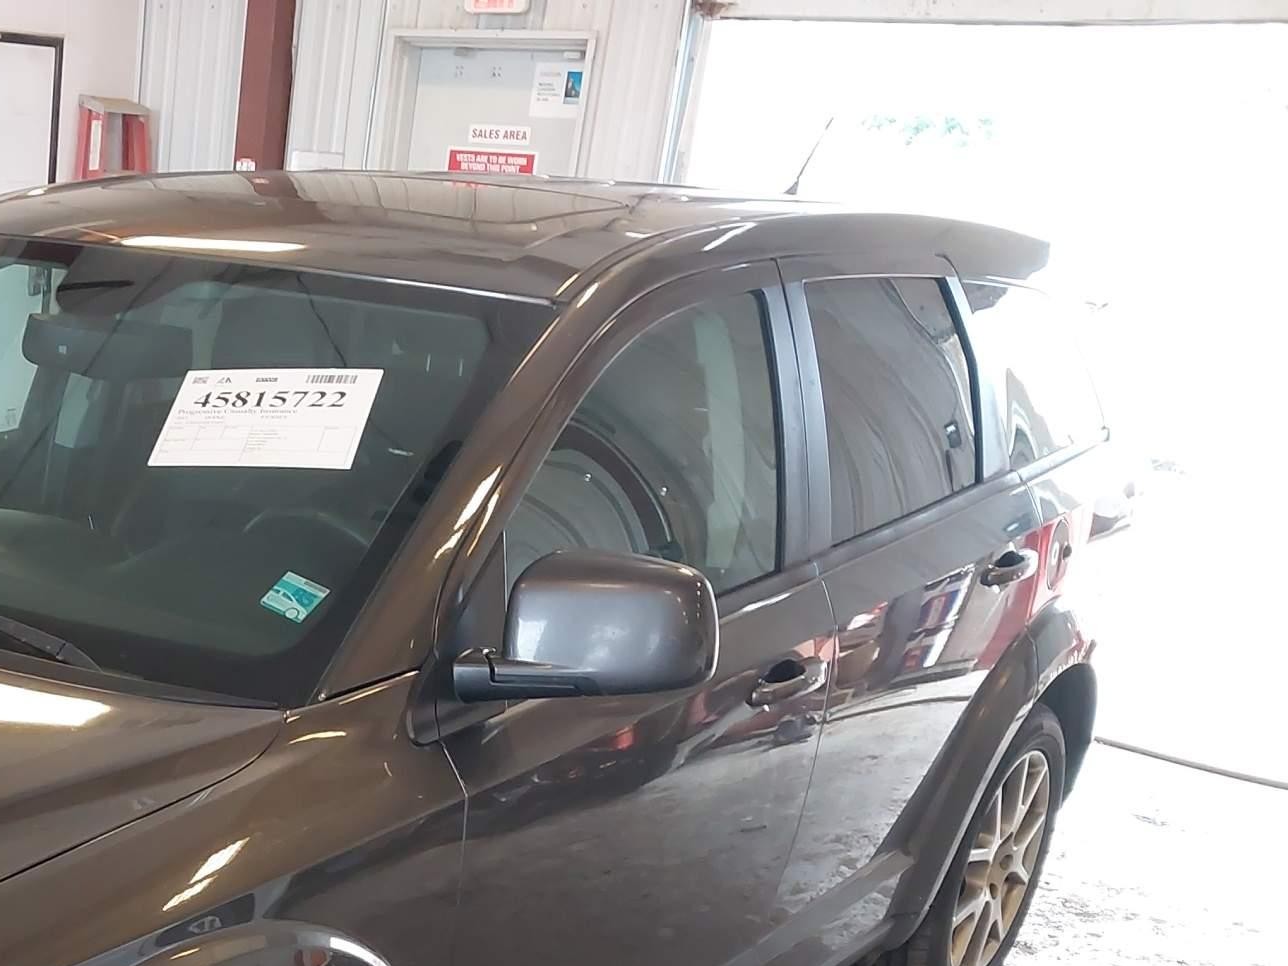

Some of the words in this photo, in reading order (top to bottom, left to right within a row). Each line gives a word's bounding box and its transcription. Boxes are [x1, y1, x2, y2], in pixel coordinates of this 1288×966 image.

[472, 128, 500, 140] SALES
[502, 130, 527, 140] AREA
[194, 391, 347, 408] 45815722
